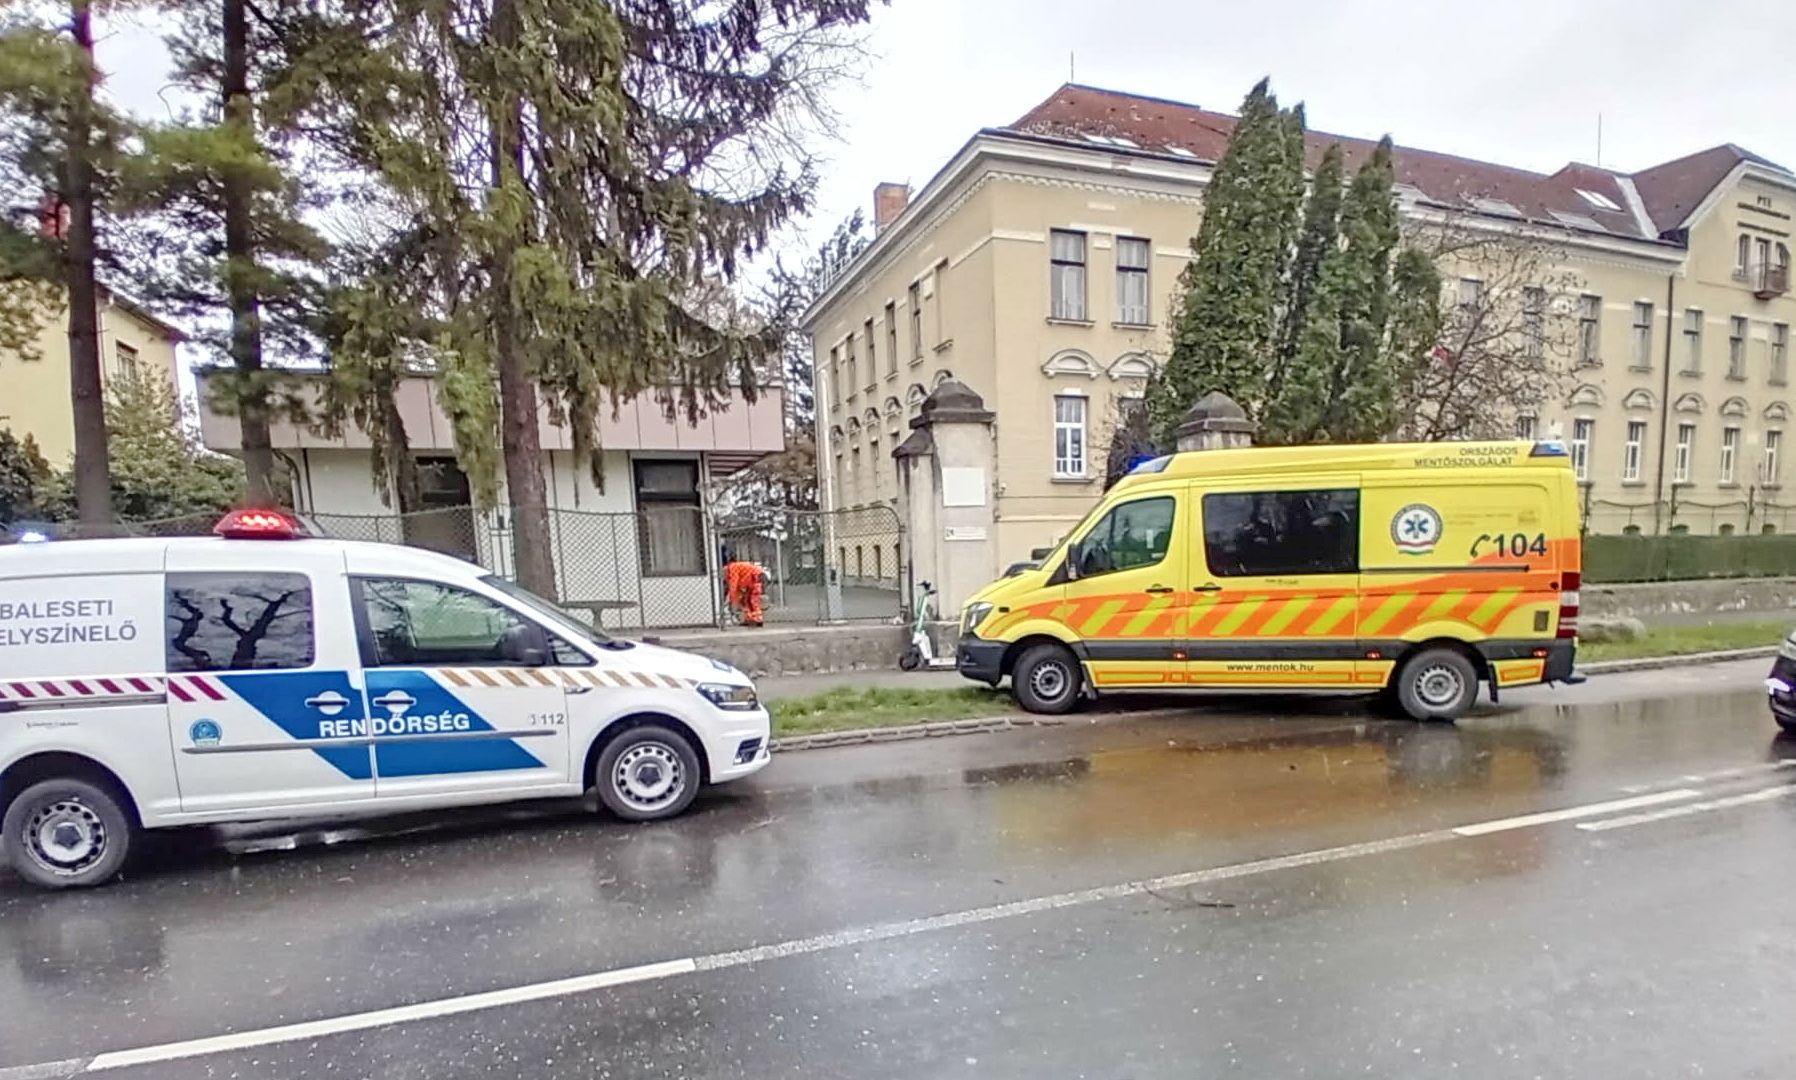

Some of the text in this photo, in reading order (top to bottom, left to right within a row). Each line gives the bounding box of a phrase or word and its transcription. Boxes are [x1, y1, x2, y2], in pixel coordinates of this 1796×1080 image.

[1493, 533, 1547, 557] 104
[0, 600, 113, 620] BALESETI
[1226, 662, 1315, 672] www.mentok.hu
[319, 711, 470, 738] RENDŐRSÉG
[540, 712, 565, 725] 112
